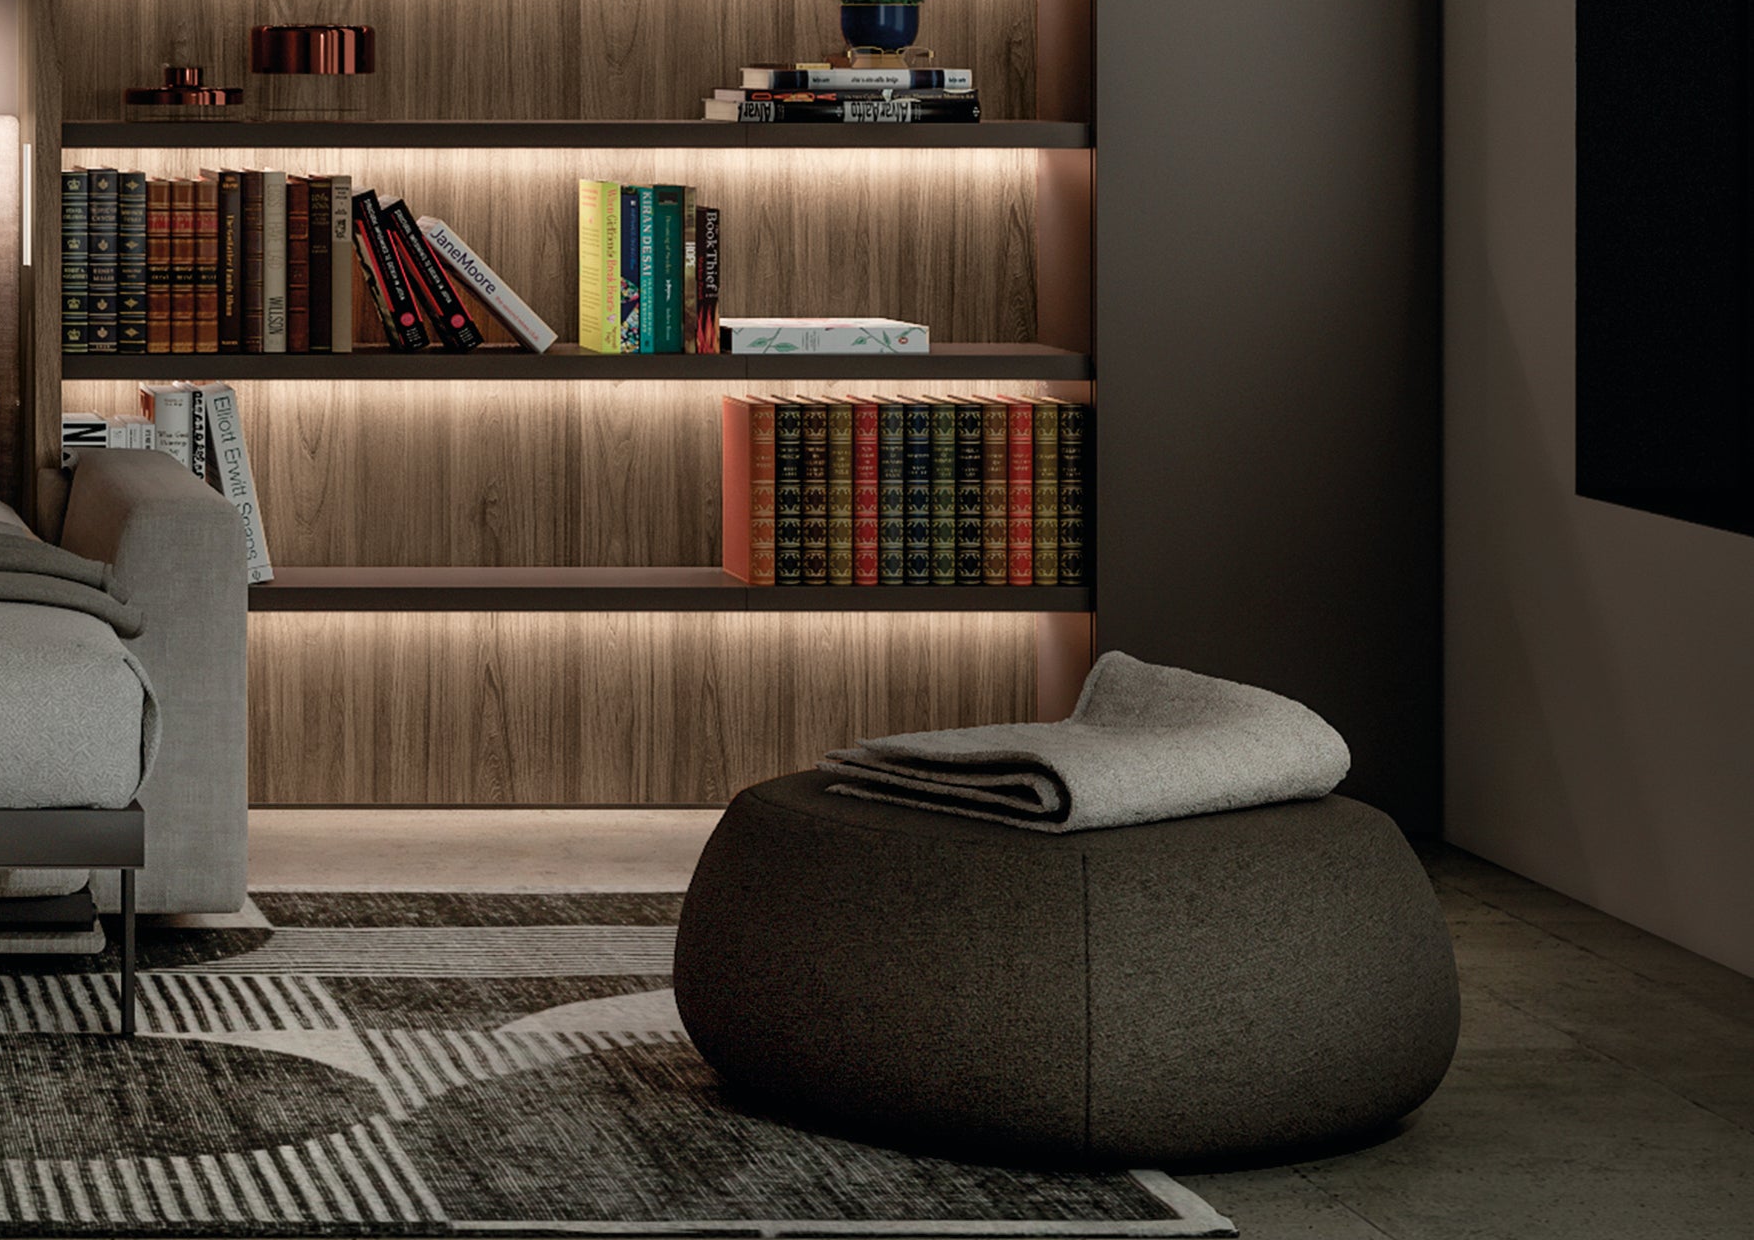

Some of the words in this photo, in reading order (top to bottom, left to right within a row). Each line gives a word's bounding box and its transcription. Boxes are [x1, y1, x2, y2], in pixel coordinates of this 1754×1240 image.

[850, 102, 879, 122] Aalto
[642, 191, 653, 233] KIRAN
[706, 211, 718, 248] Book
[226, 230, 235, 266] Godfather
[430, 229, 497, 295] JaneMoore
[642, 236, 653, 276] DESAI
[685, 241, 696, 268] HOPE
[706, 253, 718, 292] Thief
[268, 296, 284, 335] WILLSON
[214, 396, 238, 444] Elliott
[224, 448, 247, 497] Erwitt
